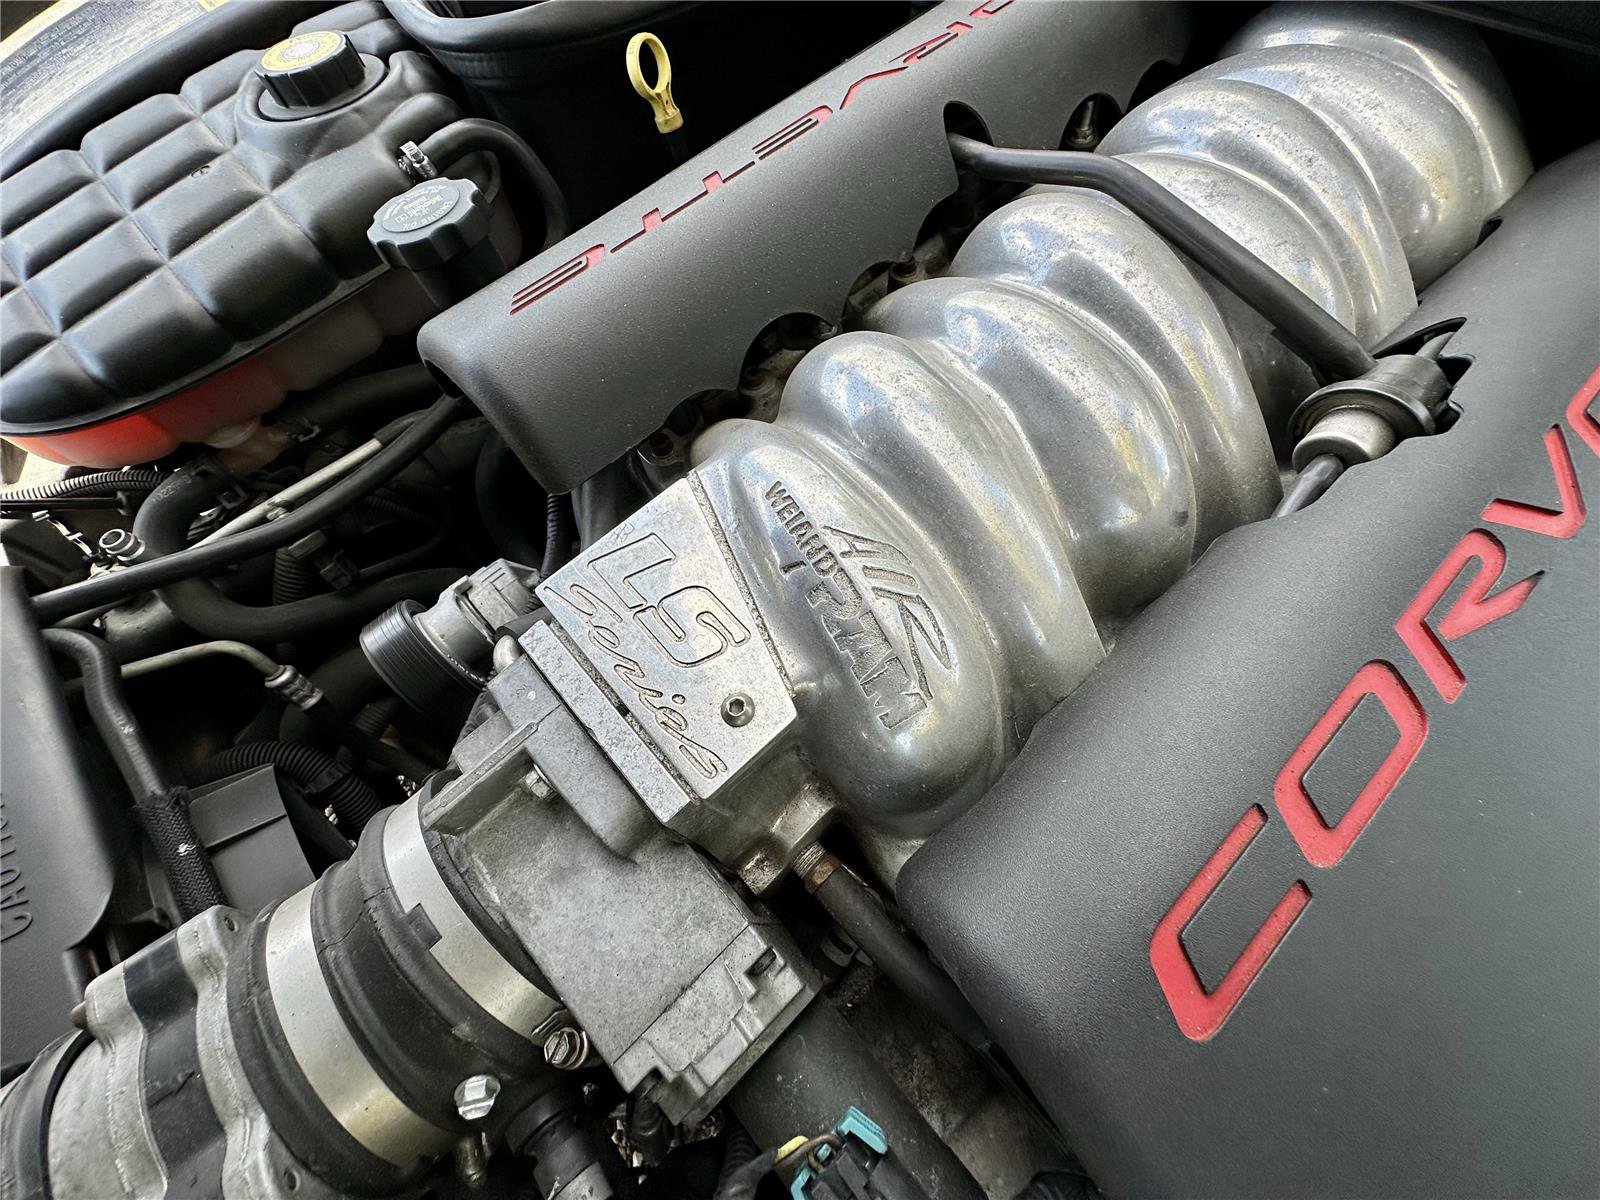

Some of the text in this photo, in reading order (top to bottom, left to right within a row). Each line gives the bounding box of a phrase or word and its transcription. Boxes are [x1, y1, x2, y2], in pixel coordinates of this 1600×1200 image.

[586, 532, 752, 669] LS
[764, 480, 840, 579] WEIAND
[543, 584, 730, 780] Series
[806, 569, 929, 731] RAM
